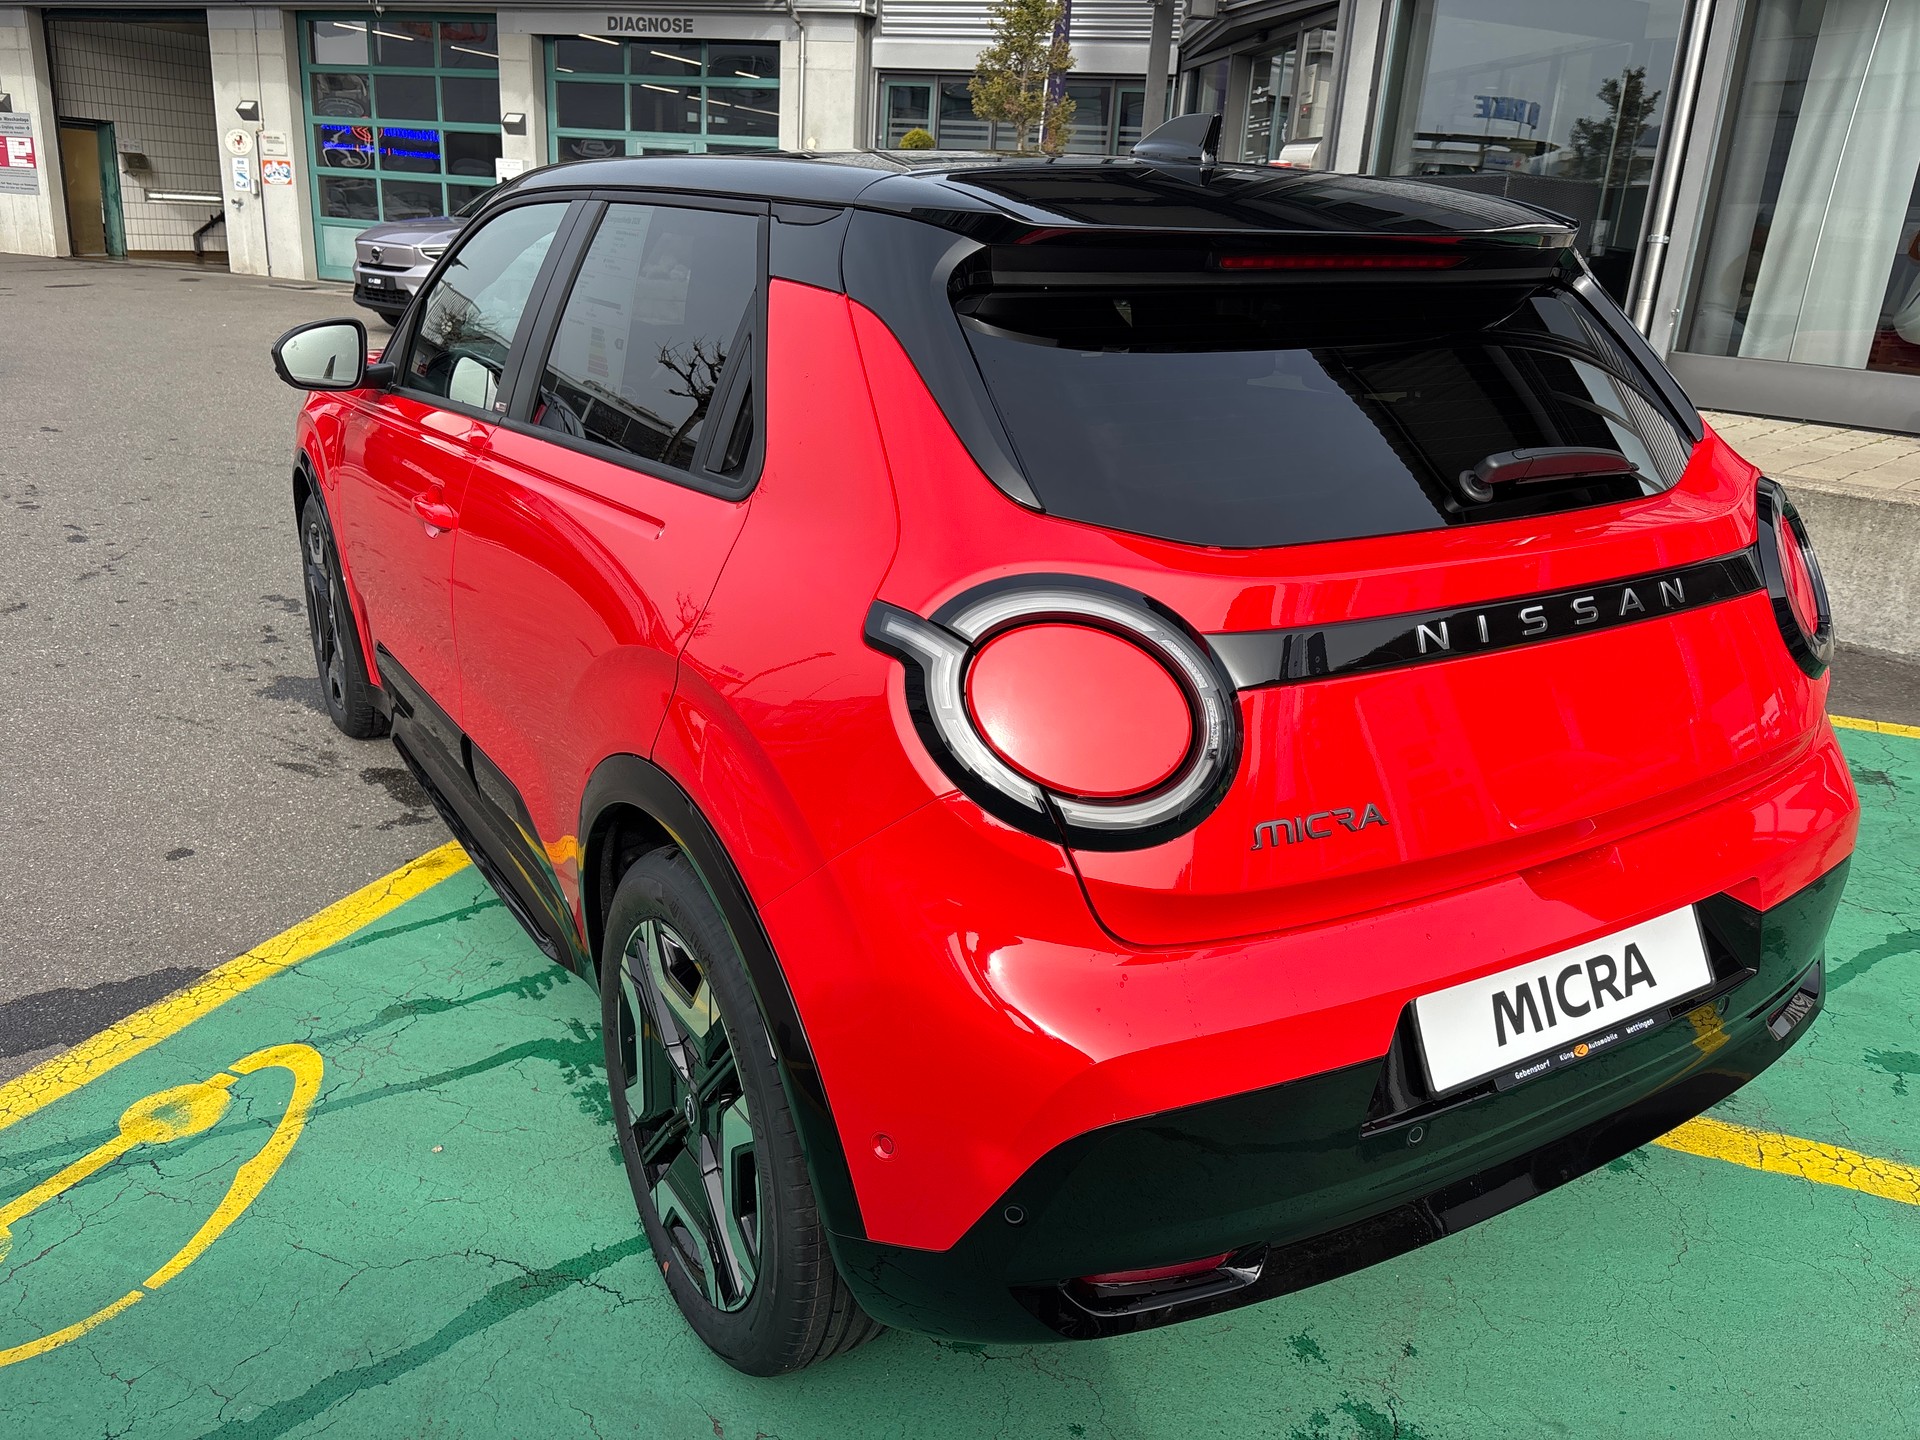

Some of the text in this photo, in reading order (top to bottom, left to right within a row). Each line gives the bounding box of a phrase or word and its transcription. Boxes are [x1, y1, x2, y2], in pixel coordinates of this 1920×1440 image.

[607, 16, 694, 33] DIAGNOSE
[1415, 577, 1689, 655] NISSAN
[1250, 802, 1389, 852] MICRA
[1491, 941, 1657, 1048] MICRA
[1515, 1060, 1550, 1079] Gebenstorf
[1589, 1033, 1618, 1049] Automobile
[1626, 1018, 1654, 1034] Wettingen
